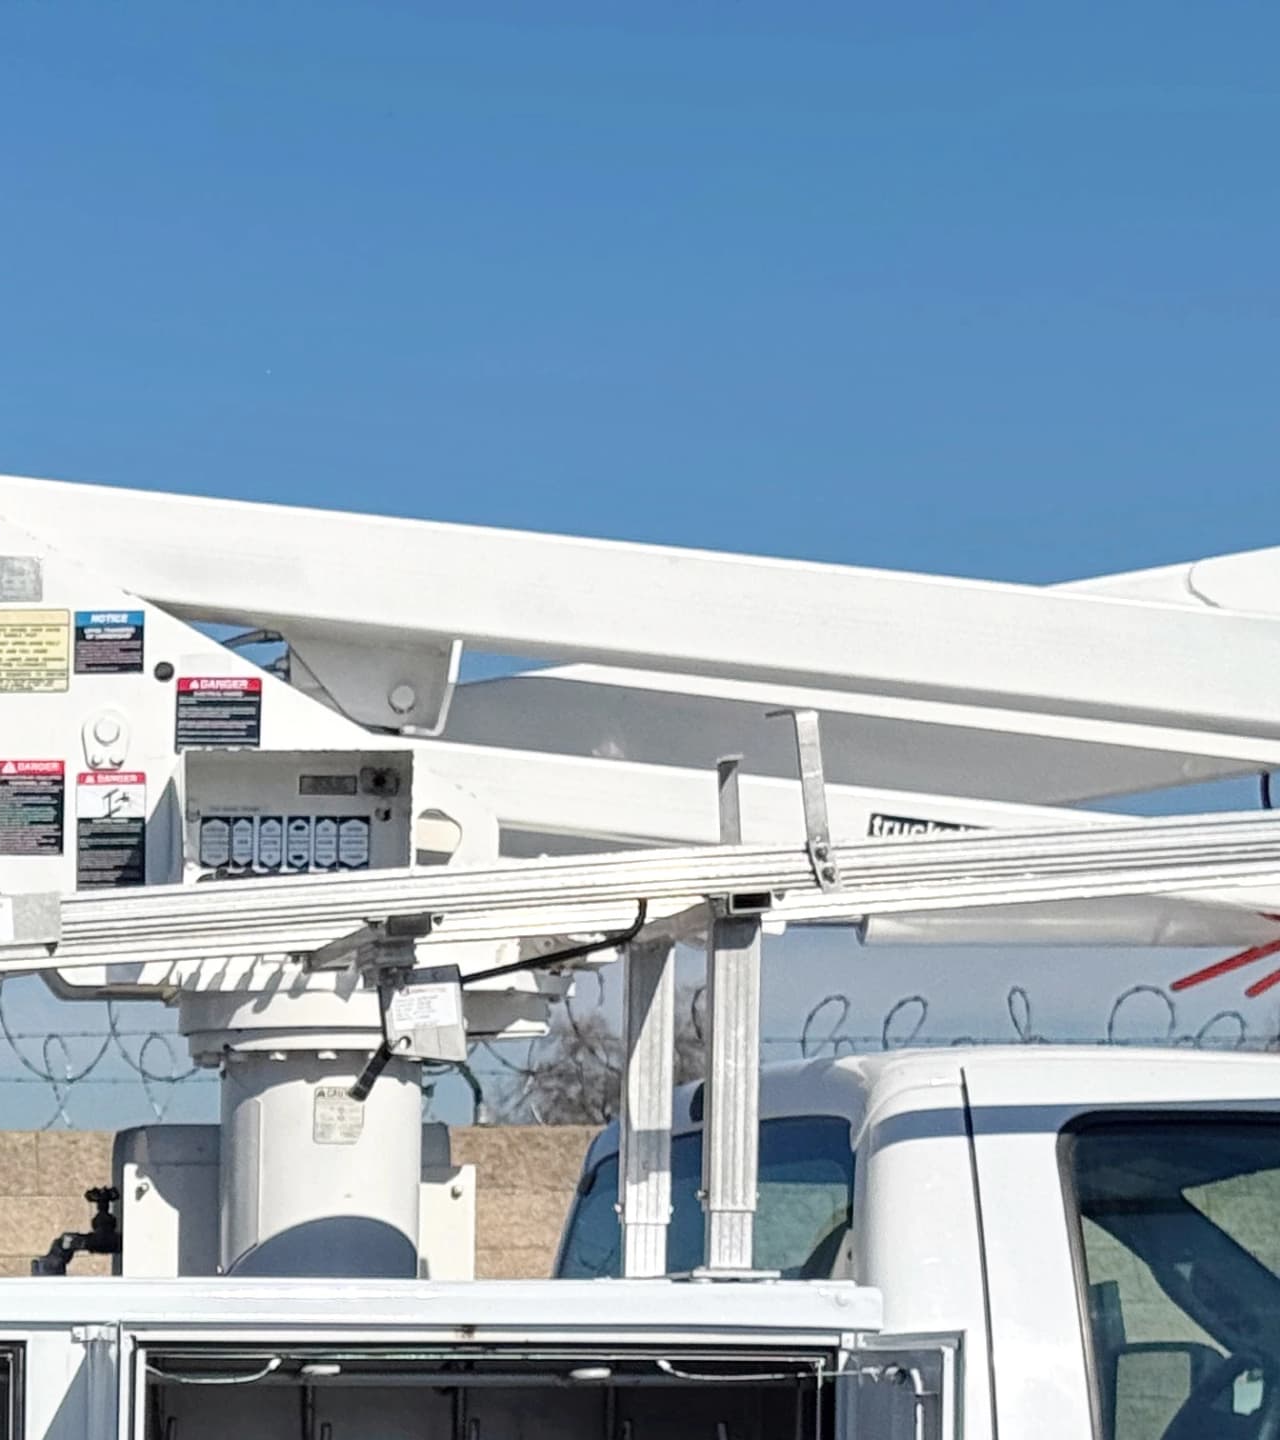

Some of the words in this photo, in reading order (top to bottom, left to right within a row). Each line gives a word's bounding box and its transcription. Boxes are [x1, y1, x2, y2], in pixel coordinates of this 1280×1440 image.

[91, 613, 128, 624] NOTICE
[200, 679, 248, 690] DANGER
[17, 762, 59, 773] DANGER
[97, 774, 138, 783] DANGER
